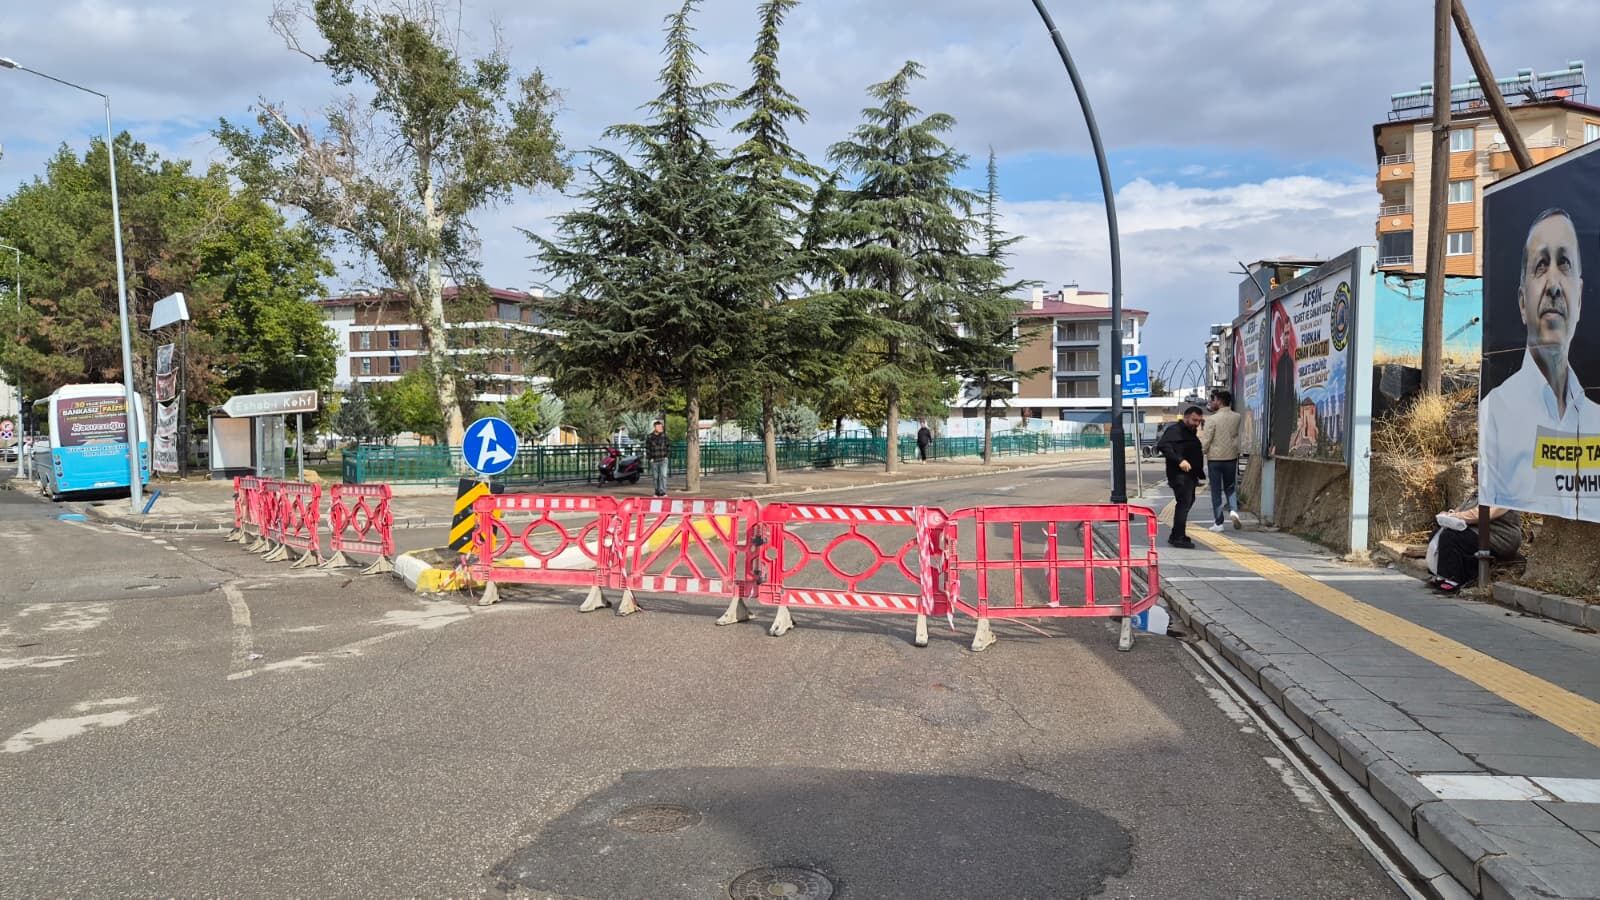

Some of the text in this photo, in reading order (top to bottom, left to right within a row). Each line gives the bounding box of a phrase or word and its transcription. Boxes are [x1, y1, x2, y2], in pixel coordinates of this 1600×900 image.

[1302, 287, 1322, 308] AFŞİN
[1125, 360, 1141, 382] P
[283, 396, 312, 408] Kehf
[1541, 444, 1583, 461] RECEP
[1555, 475, 1600, 492] CUMH
